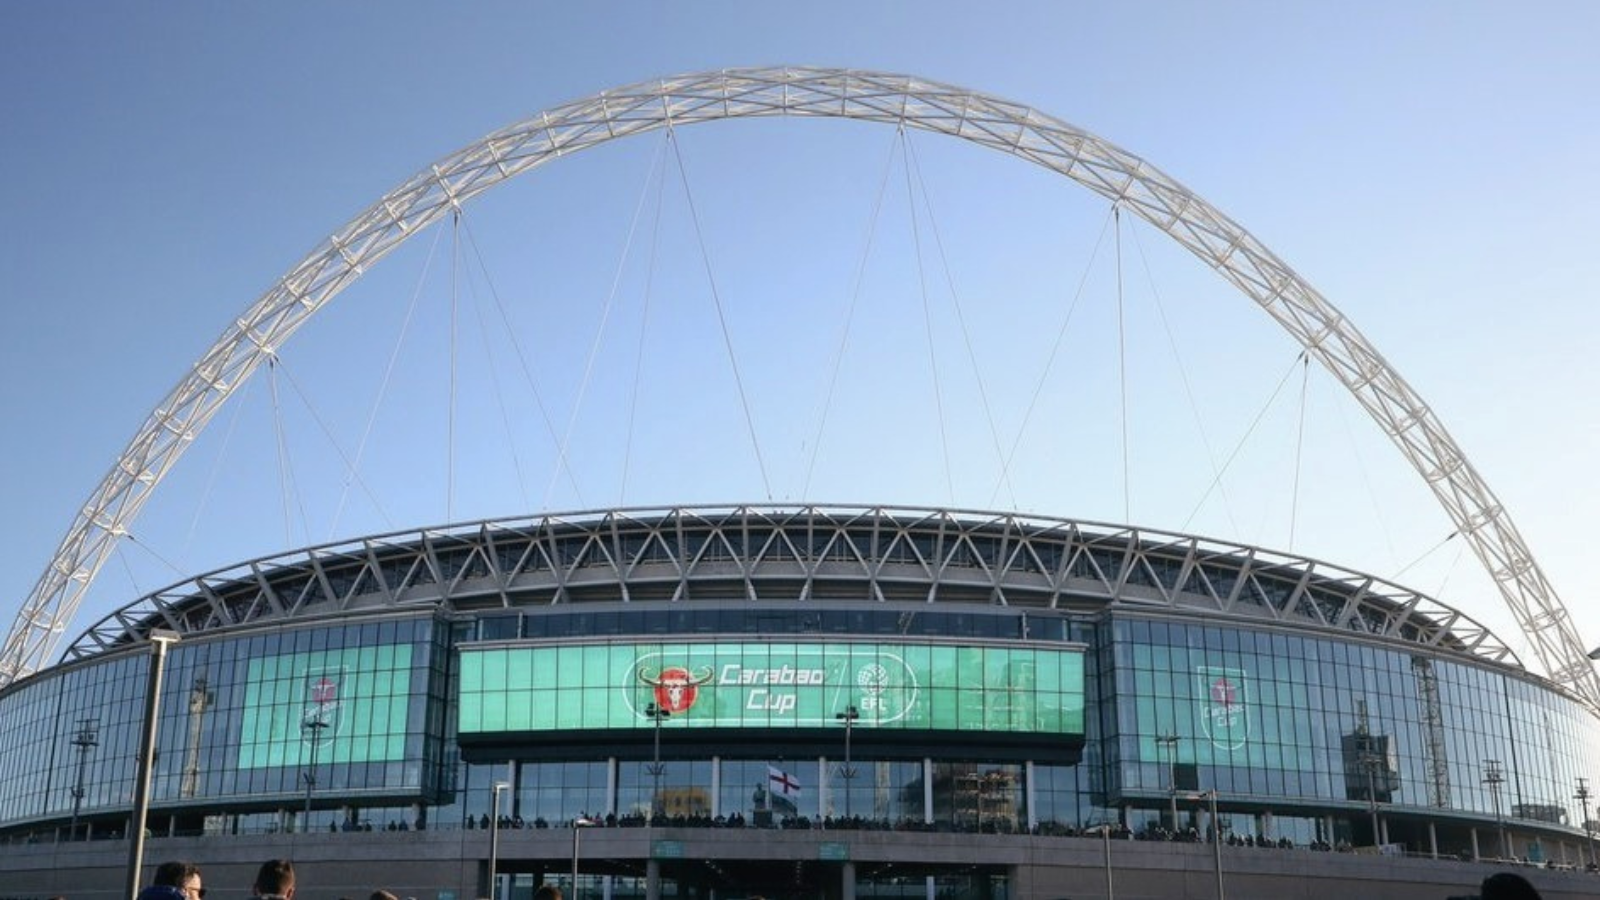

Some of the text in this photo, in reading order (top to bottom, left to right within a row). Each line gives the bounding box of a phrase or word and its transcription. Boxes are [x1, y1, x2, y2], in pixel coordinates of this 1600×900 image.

[720, 664, 823, 684] Carabao
[746, 689, 796, 714] Cup
[861, 697, 887, 710] EFL
